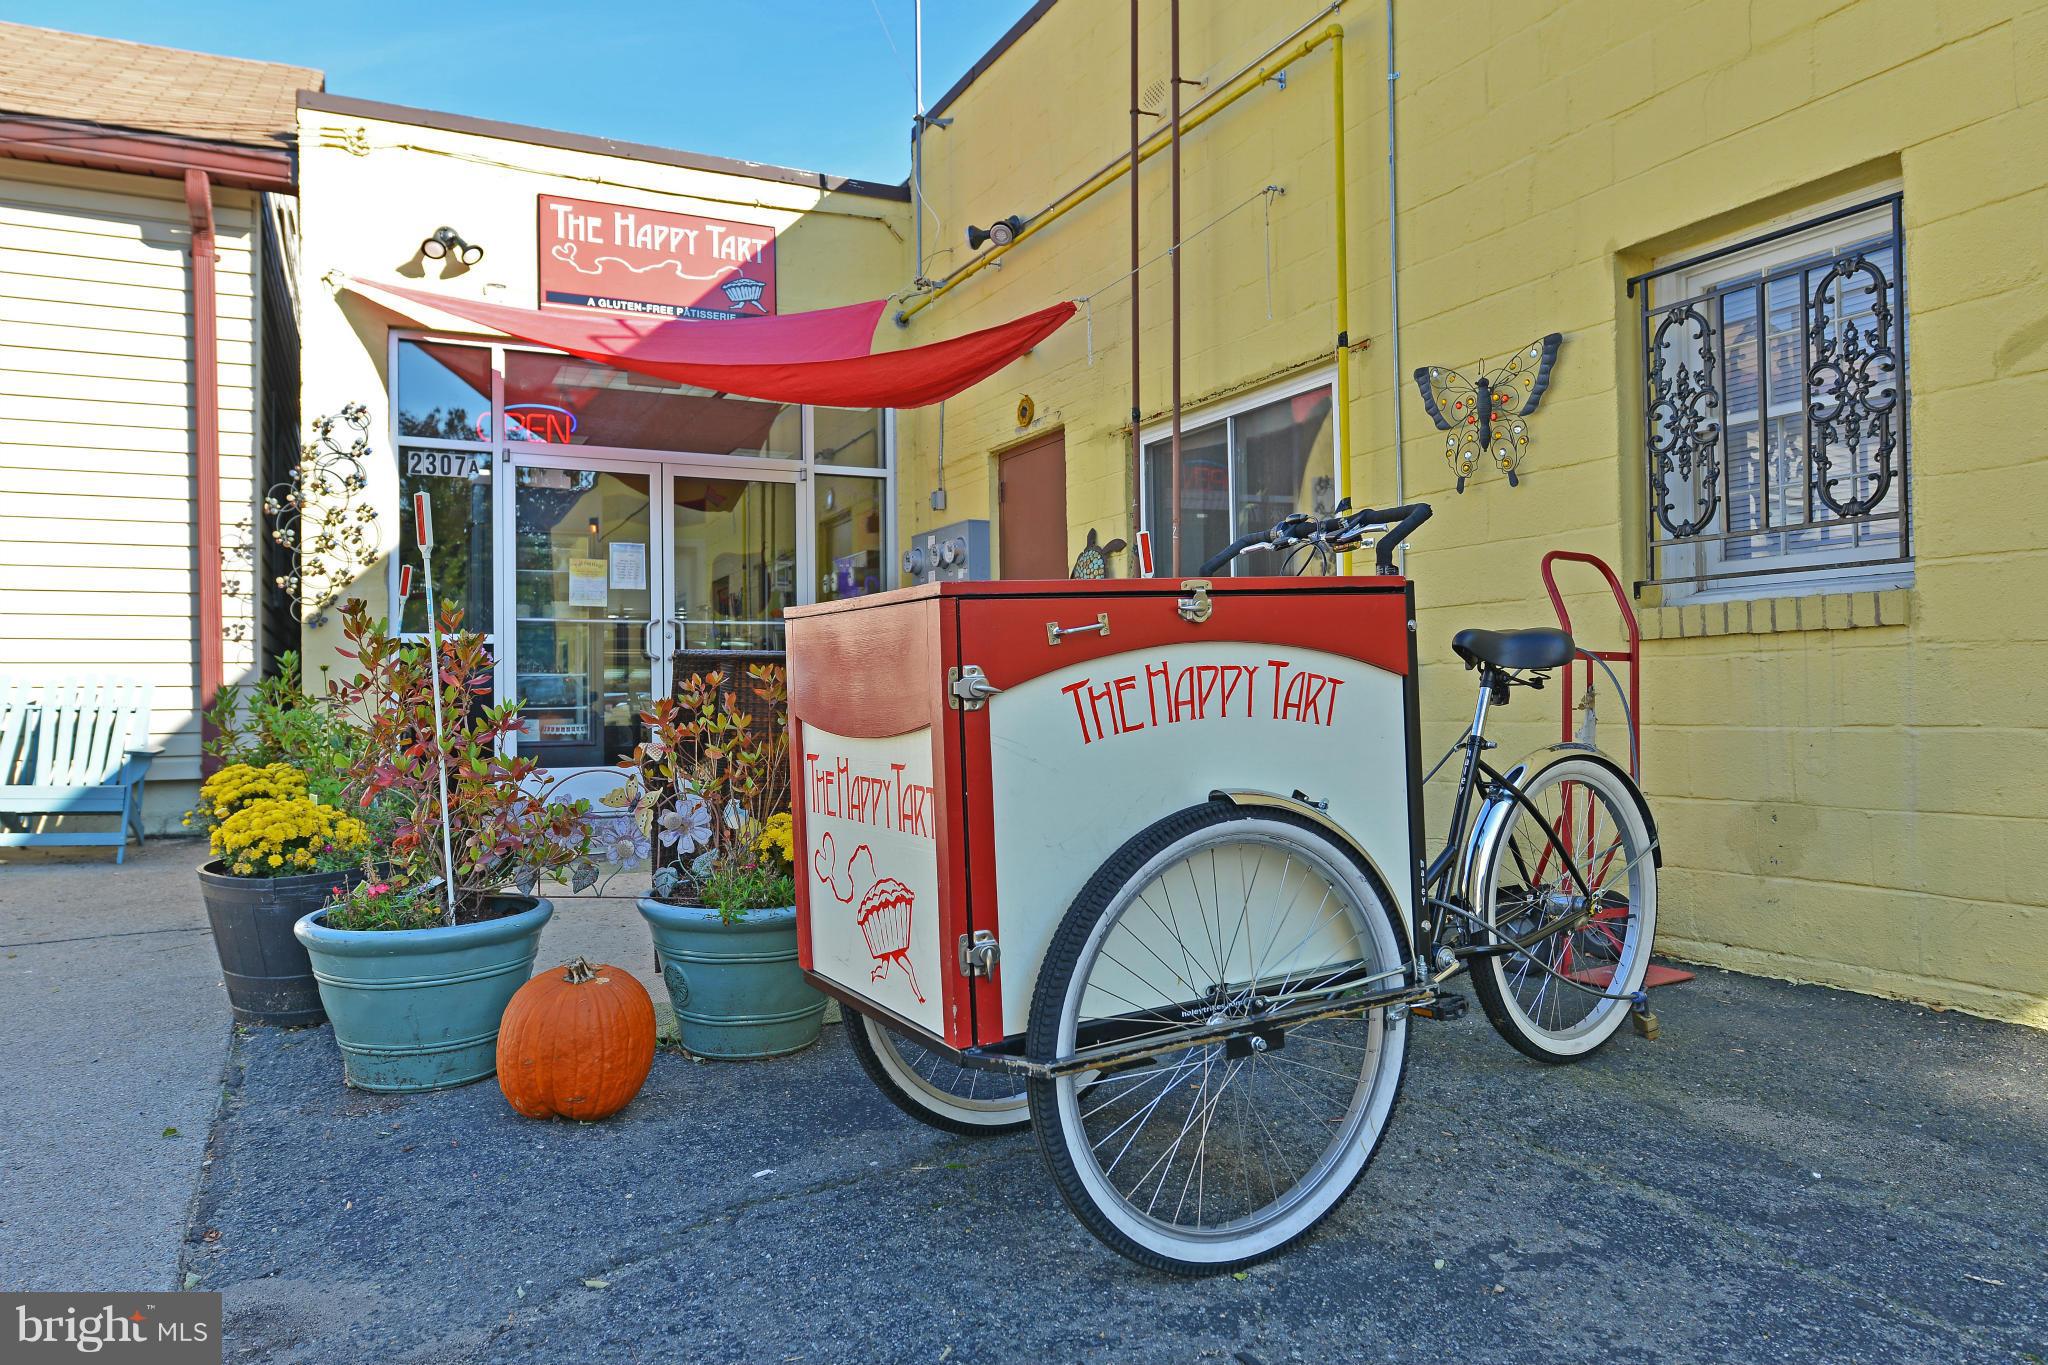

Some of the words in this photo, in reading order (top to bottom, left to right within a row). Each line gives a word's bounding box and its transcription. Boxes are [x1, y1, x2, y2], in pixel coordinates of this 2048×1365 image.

[549, 203, 604, 244] THE
[614, 211, 699, 256] HAPPY
[705, 224, 768, 264] TART
[587, 297, 596, 308] A
[598, 298, 674, 316] GLUTEN-FREE
[1061, 678, 1145, 745] THE
[1145, 661, 1260, 727] HAPPY
[1268, 660, 1345, 727] TART
[806, 753, 837, 817] THE
[836, 757, 892, 829] HAPPY
